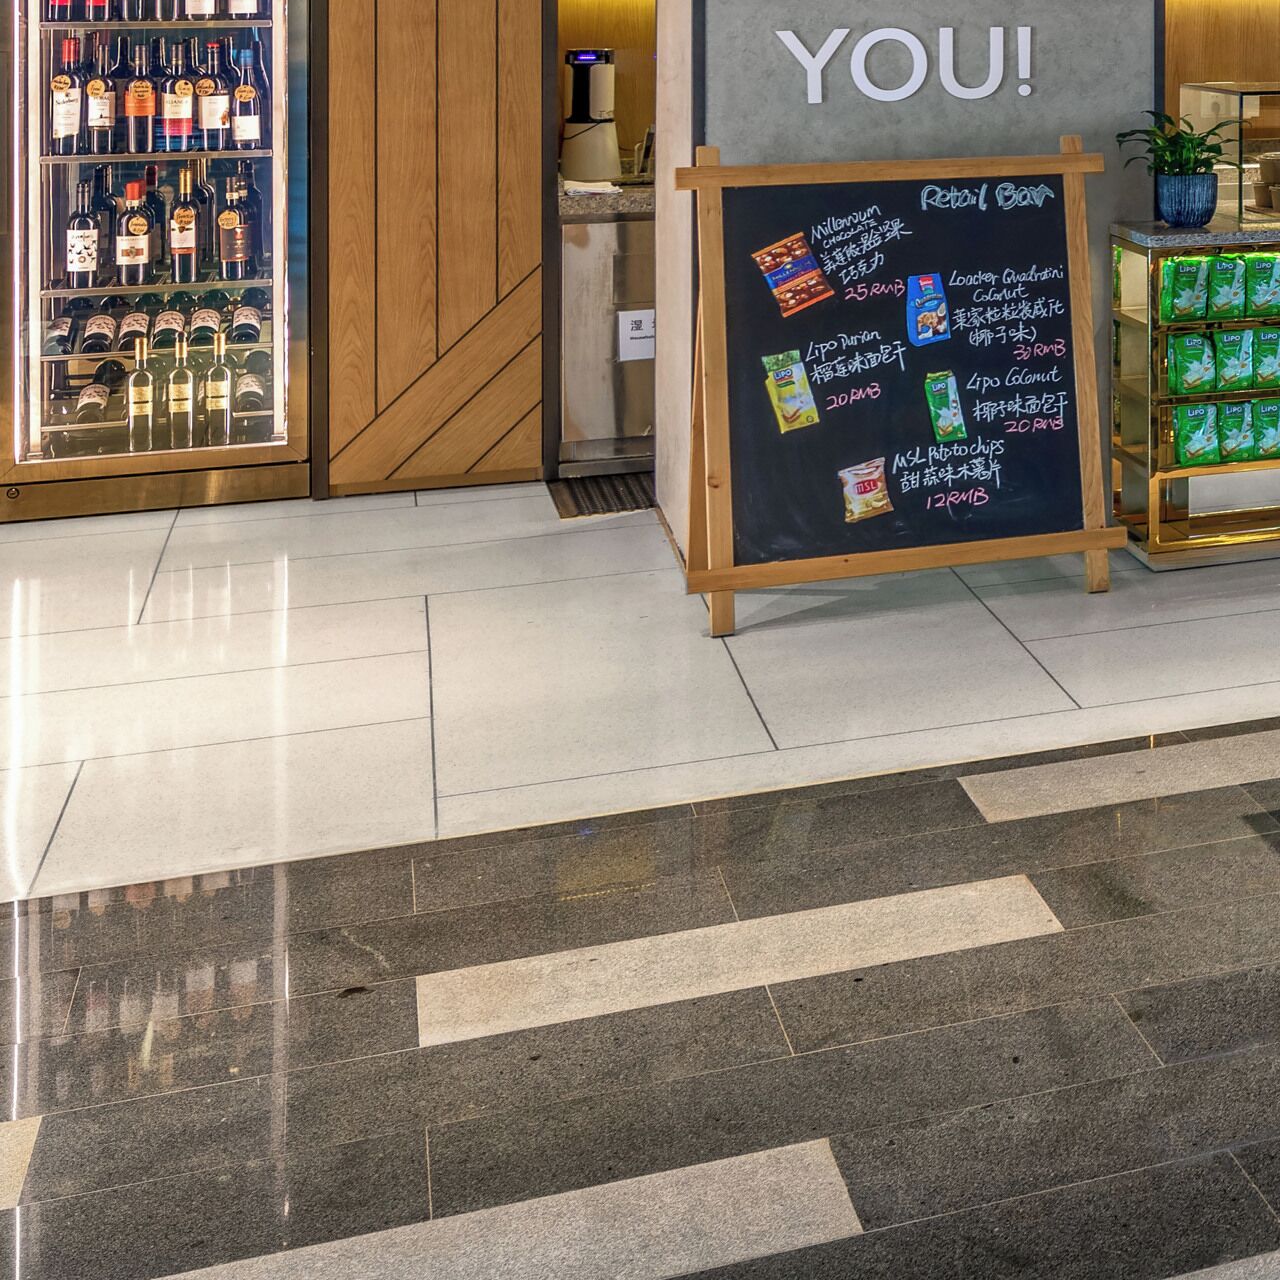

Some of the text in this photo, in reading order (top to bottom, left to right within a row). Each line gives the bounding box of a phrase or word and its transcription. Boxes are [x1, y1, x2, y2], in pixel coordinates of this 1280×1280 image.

[775, 24, 1034, 104] YOU!
[920, 182, 1054, 212] Retail Bar
[823, 219, 877, 248] CHOCOLATE
[838, 252, 884, 284] 巧克力
[948, 270, 999, 286] Loacker
